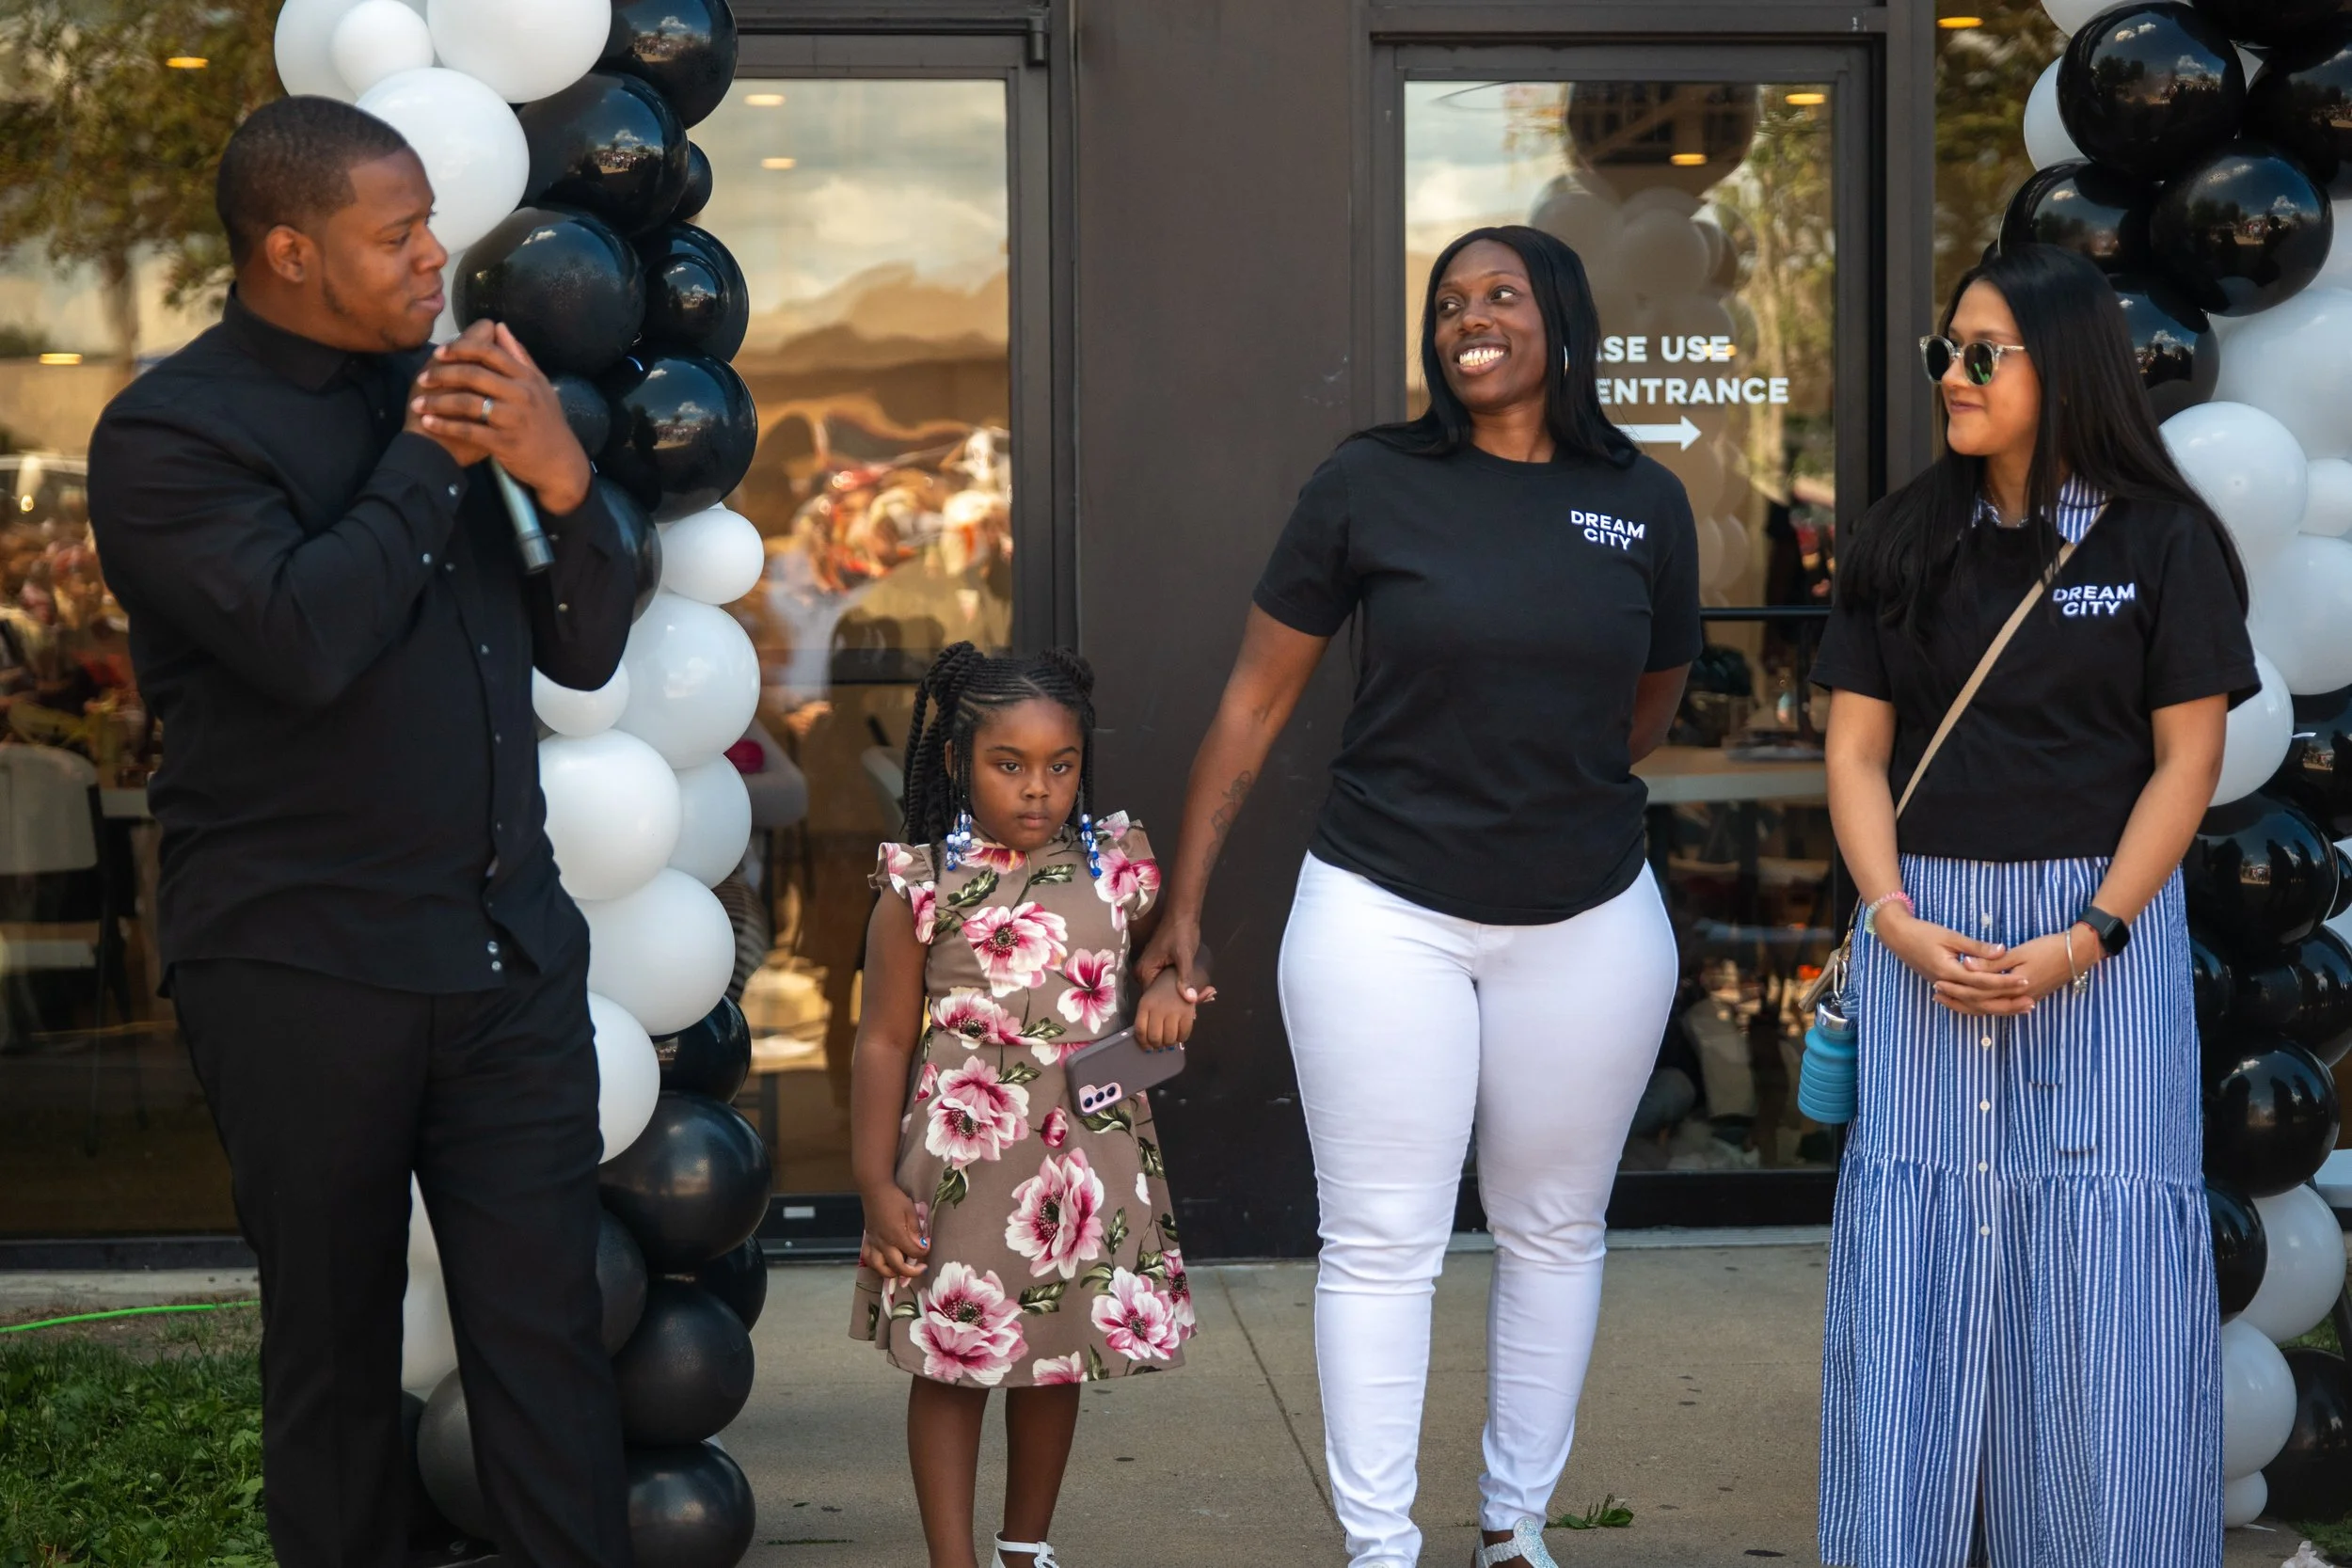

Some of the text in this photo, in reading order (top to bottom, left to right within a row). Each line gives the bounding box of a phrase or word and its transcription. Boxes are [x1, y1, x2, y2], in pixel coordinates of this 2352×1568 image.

[1597, 336, 1730, 363] SE USE
[1596, 377, 1789, 404] ENTRANCE
[1570, 510, 1645, 539] DREAM
[1583, 528, 1631, 550] CITY
[2052, 582, 2136, 601] DREAM
[2062, 600, 2122, 617] CITY
